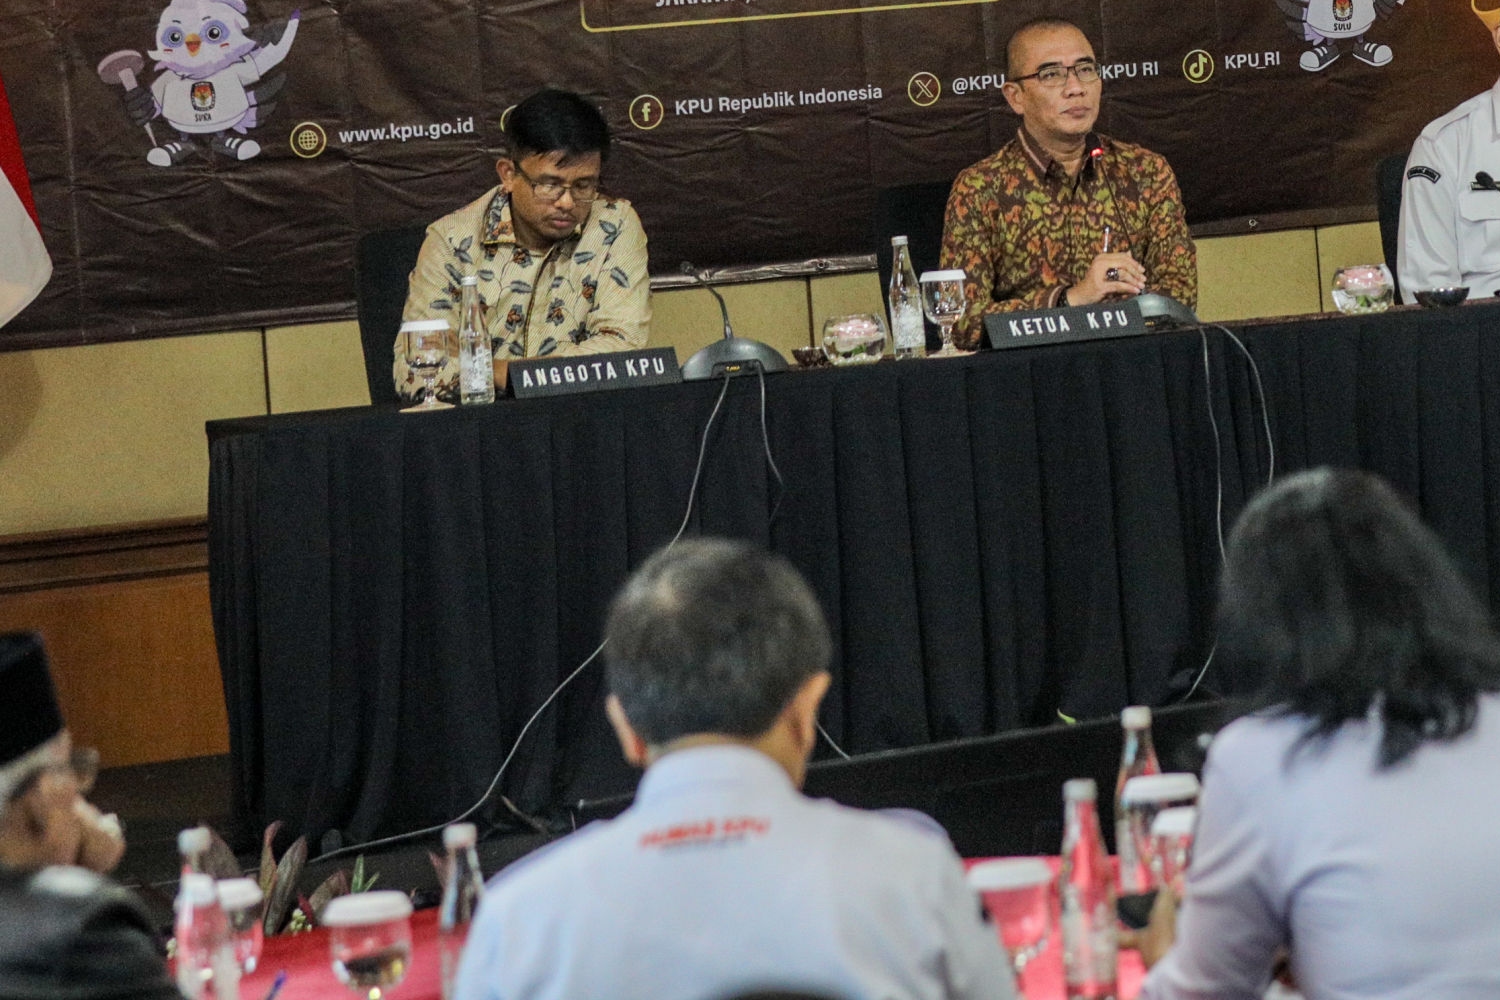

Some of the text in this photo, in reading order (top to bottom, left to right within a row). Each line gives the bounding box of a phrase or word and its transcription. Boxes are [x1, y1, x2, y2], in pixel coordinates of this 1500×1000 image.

[1333, 22, 1352, 31] SULU
[1098, 60, 1159, 80] KPU RI
[1224, 50, 1281, 71] KPU_RI
[675, 84, 883, 116] KPU Republik Indonesia
[339, 116, 475, 145] www.kpu.go.id
[1008, 309, 1128, 337] KETUA KPU
[522, 360, 619, 388] ANGGOTA
[626, 357, 666, 378] KPU
